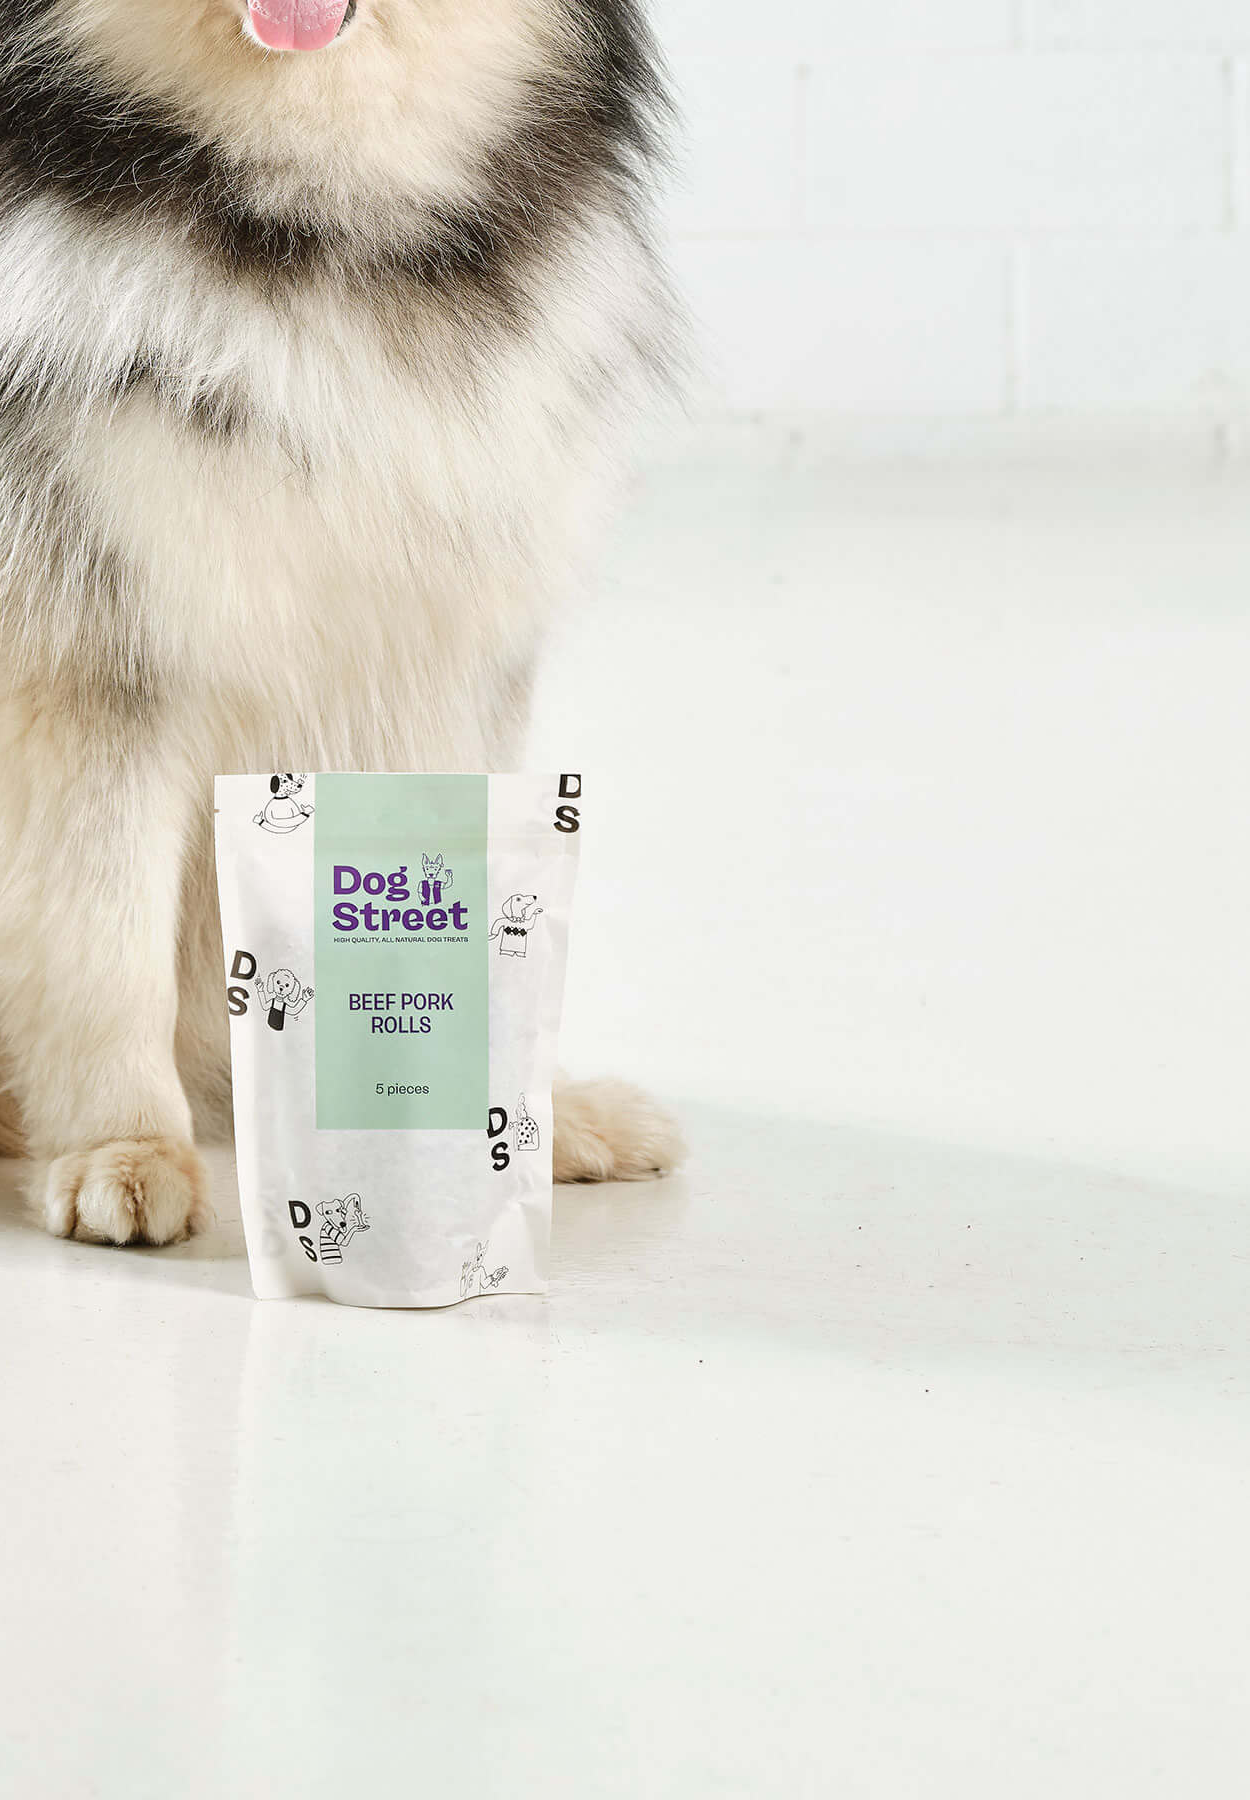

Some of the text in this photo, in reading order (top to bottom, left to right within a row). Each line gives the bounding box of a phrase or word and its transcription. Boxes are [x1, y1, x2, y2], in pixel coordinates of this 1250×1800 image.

[333, 865, 410, 902] Dog
[332, 901, 468, 931] Street
[351, 936, 381, 944] QUALITY,
[349, 993, 454, 1010] BEEF PORK
[371, 1016, 431, 1034] ROLLS
[375, 1083, 430, 1096] 5 pieces
